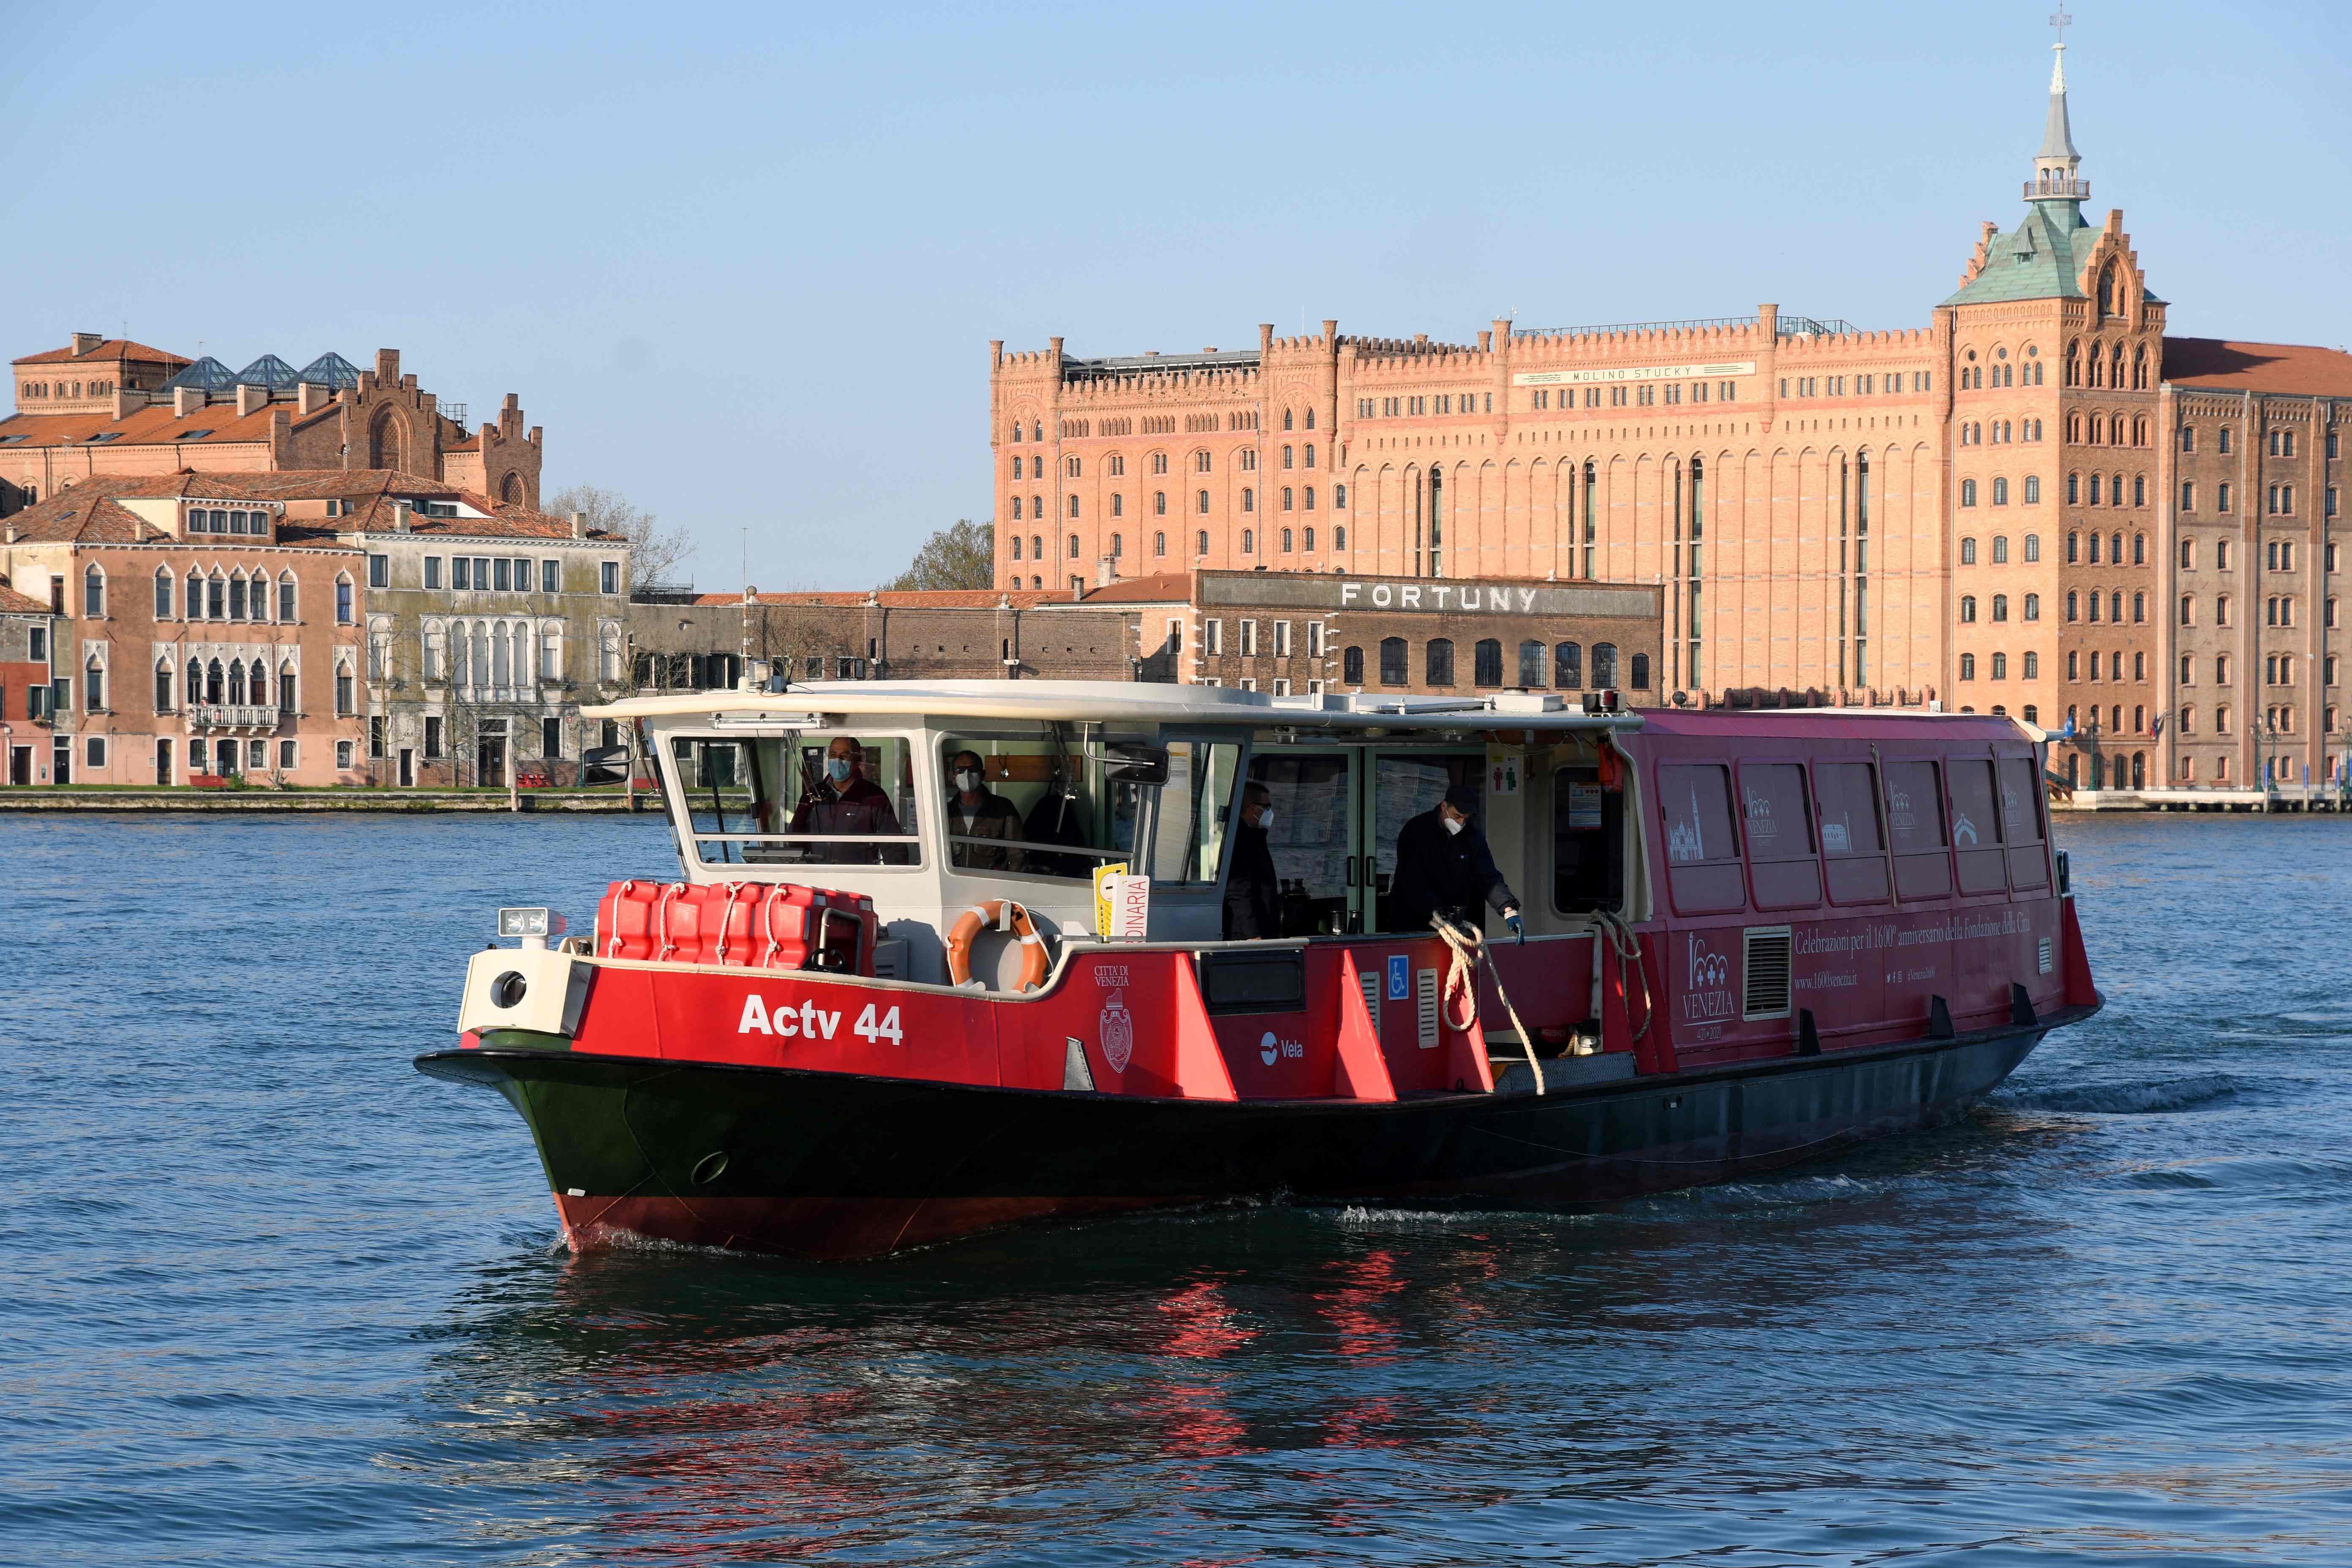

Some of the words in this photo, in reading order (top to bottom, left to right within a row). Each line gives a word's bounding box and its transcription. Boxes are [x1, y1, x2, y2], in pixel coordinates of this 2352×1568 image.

[1573, 370, 1625, 381] MOLINO
[1635, 366, 1691, 378] STUCKY
[1342, 583, 1537, 612] FORTUNY
[1748, 819, 1777, 834] VENEZIA
[1890, 812, 1916, 826] VENEZIA
[1125, 881, 1147, 944] DINARIA
[1796, 928, 1848, 954] Celebrazioni
[1851, 934, 1864, 959] per
[1866, 924, 1872, 949] il
[1898, 922, 1944, 946] anniversario
[1946, 916, 1963, 941] della
[1965, 914, 2001, 939] Fondazione
[2002, 911, 2016, 935] della
[1120, 965, 1129, 976] DI
[1094, 976, 1129, 987] VENEZIA
[1795, 970, 1857, 991] www.1600.venezia.it
[1682, 991, 1734, 1019] VENEZIA
[738, 994, 842, 1040] Actv
[854, 1003, 903, 1046] 44
[1280, 1040, 1303, 1058] Vela
